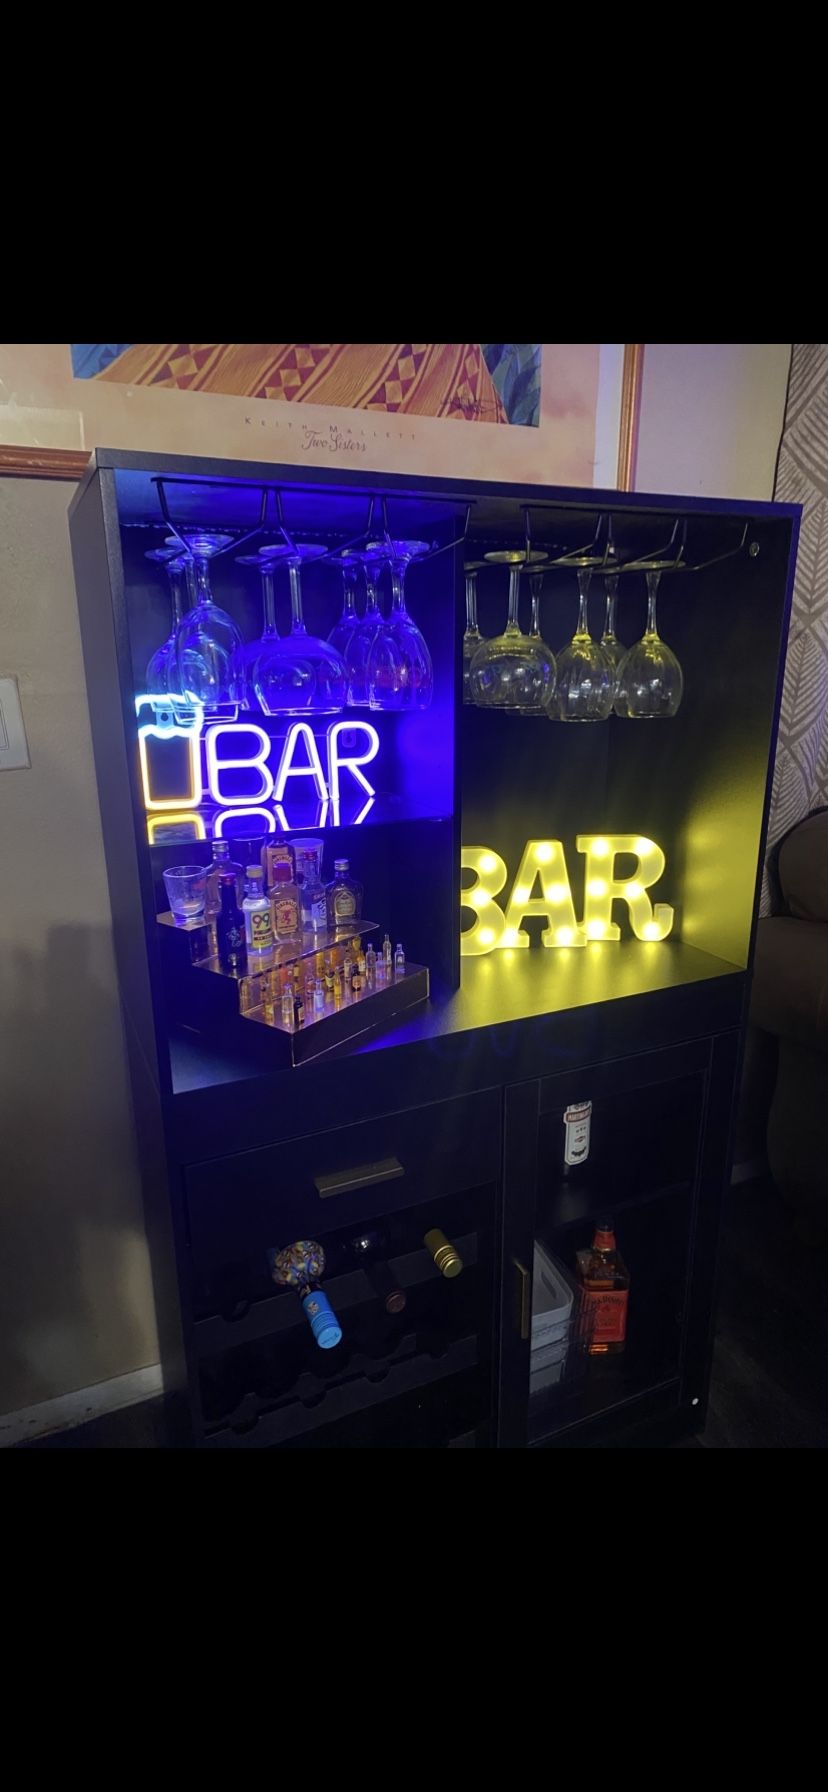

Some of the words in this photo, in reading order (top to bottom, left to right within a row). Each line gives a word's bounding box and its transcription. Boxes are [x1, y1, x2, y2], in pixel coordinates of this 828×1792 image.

[301, 429, 328, 450] Two
[328, 433, 368, 452] Sisters
[205, 720, 381, 807] BAR
[252, 912, 270, 929] 99
[460, 833, 675, 956] BAR
